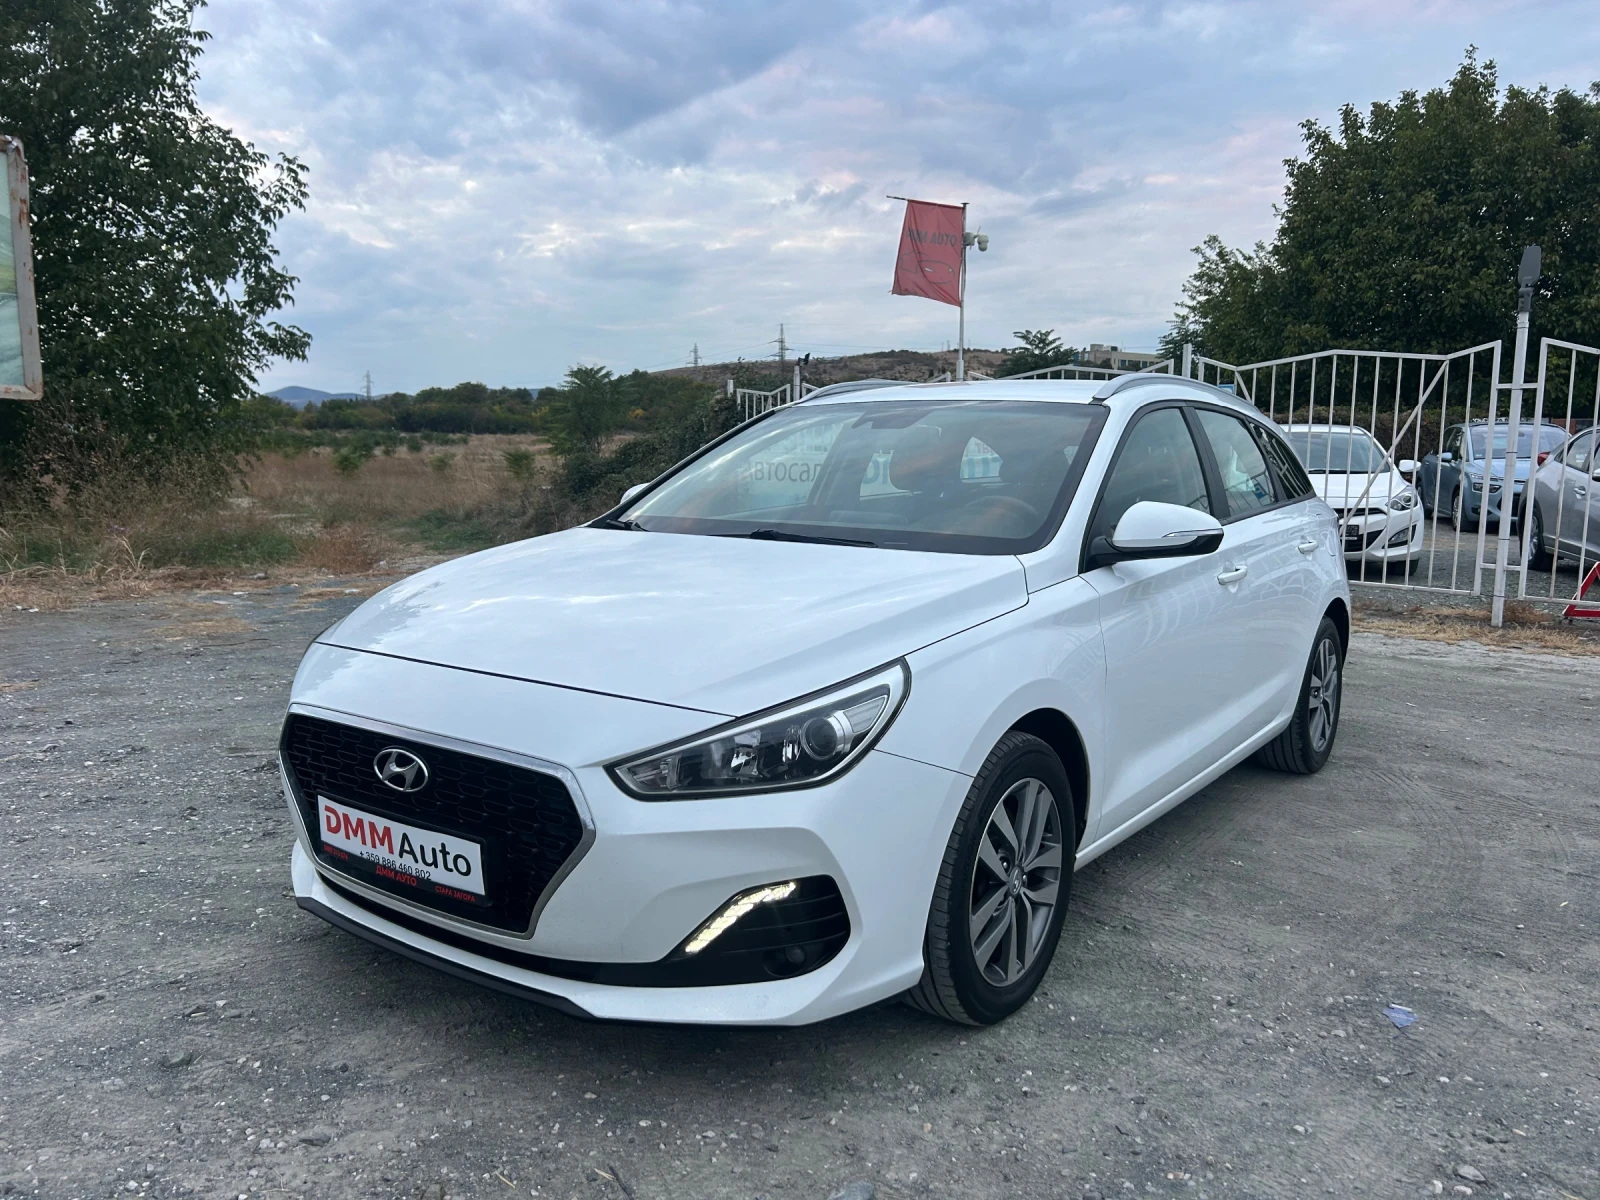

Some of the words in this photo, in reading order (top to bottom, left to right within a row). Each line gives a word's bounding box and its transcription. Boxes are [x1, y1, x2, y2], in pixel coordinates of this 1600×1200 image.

[930, 231, 957, 248] AUTO
[324, 804, 395, 855] DMM
[399, 832, 472, 877] Auto
[375, 864, 395, 879] ДММ
[396, 872, 417, 887] АУТО
[414, 867, 431, 881] 802
